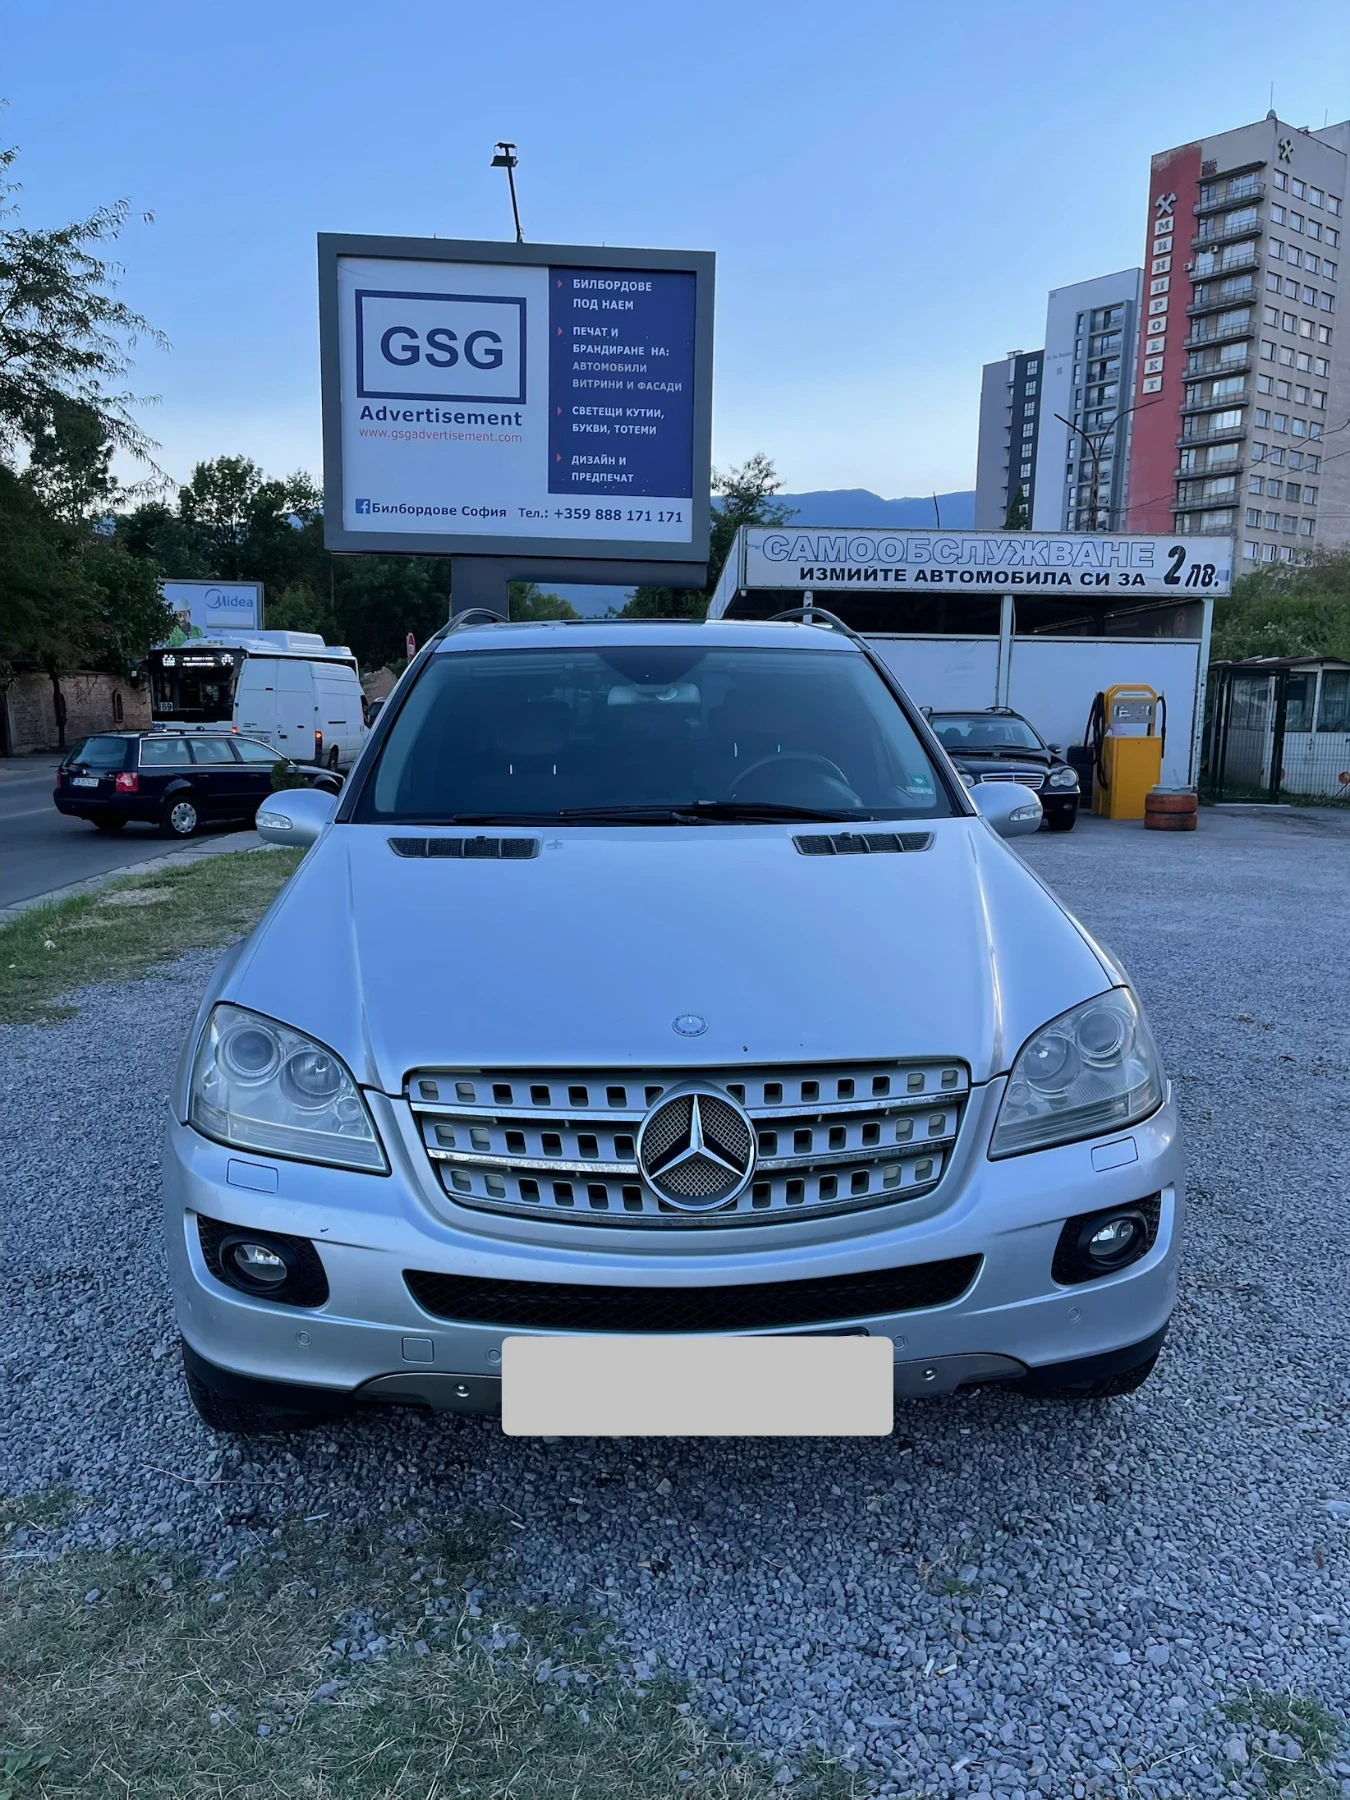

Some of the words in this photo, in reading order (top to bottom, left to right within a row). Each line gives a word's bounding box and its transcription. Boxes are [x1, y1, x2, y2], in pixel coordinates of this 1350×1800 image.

[573, 279, 652, 292] БИЛБОРДОВЕ
[573, 298, 598, 310] ПОД
[602, 300, 634, 310] НАЕМ
[1146, 219, 1171, 392] МИНПРОЕКТ
[573, 326, 608, 337] ПЕЧАТ
[611, 328, 619, 338] И
[380, 326, 503, 370] GSG
[573, 344, 645, 356] БРАНДИРАНЕ
[651, 347, 670, 356] НА:
[572, 361, 647, 373] АВТОМОБИЛИ
[572, 379, 623, 390] ВИТРИНИ
[626, 381, 634, 390] И
[637, 382, 682, 393] ФАСАДИ
[360, 405, 523, 426] Advertisement
[572, 406, 623, 418] СВЕТЕЩИ
[626, 408, 665, 420] КУТИИ,
[359, 428, 522, 443] www.gsgadvertisement.com
[572, 423, 611, 435] БУКВИ,
[614, 425, 657, 435] ТОТЕМИ
[571, 454, 616, 466] ДИЗАЙН
[619, 457, 627, 466] И
[571, 472, 634, 483] ПРЕДПЕЧАТ
[372, 503, 457, 517] Билбордове
[461, 505, 507, 519] София
[518, 507, 549, 519] Тел.:
[553, 508, 591, 520] +359
[595, 509, 622, 522] 888
[627, 510, 652, 522] 171
[657, 511, 683, 523] 171
[762, 535, 1155, 568] САМООБСЛУЖВАНЕ
[1164, 545, 1187, 585] 2
[800, 565, 907, 582] ИЗМИЙТЕ
[914, 569, 1072, 586] АВТОМОБИЛА
[1080, 572, 1110, 586] СИ
[1118, 573, 1146, 586] ЗА
[208, 591, 253, 608] Midea
[161, 702, 173, 711] 69
